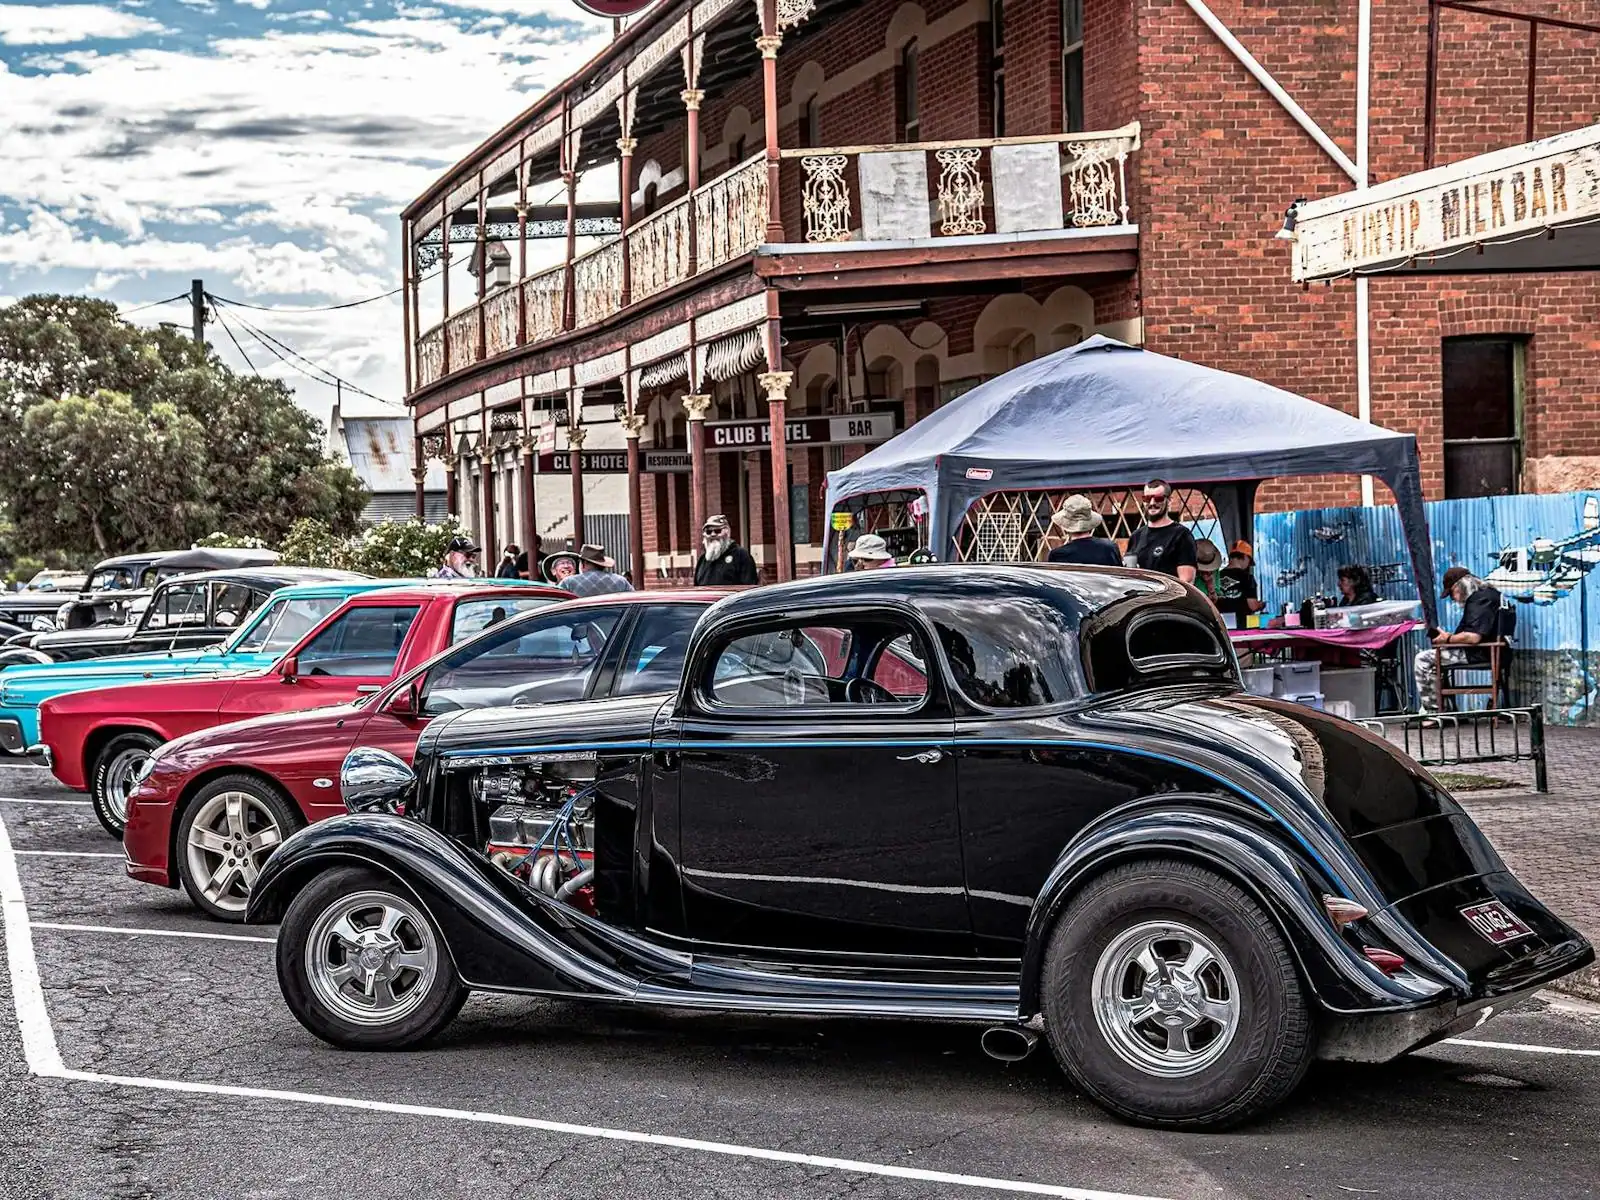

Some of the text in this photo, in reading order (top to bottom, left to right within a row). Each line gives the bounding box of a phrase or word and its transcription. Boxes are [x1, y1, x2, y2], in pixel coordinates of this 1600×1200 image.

[714, 423, 811, 445] CLUB HTEL
[849, 420, 872, 437] BAR
[554, 455, 587, 469] CLB
